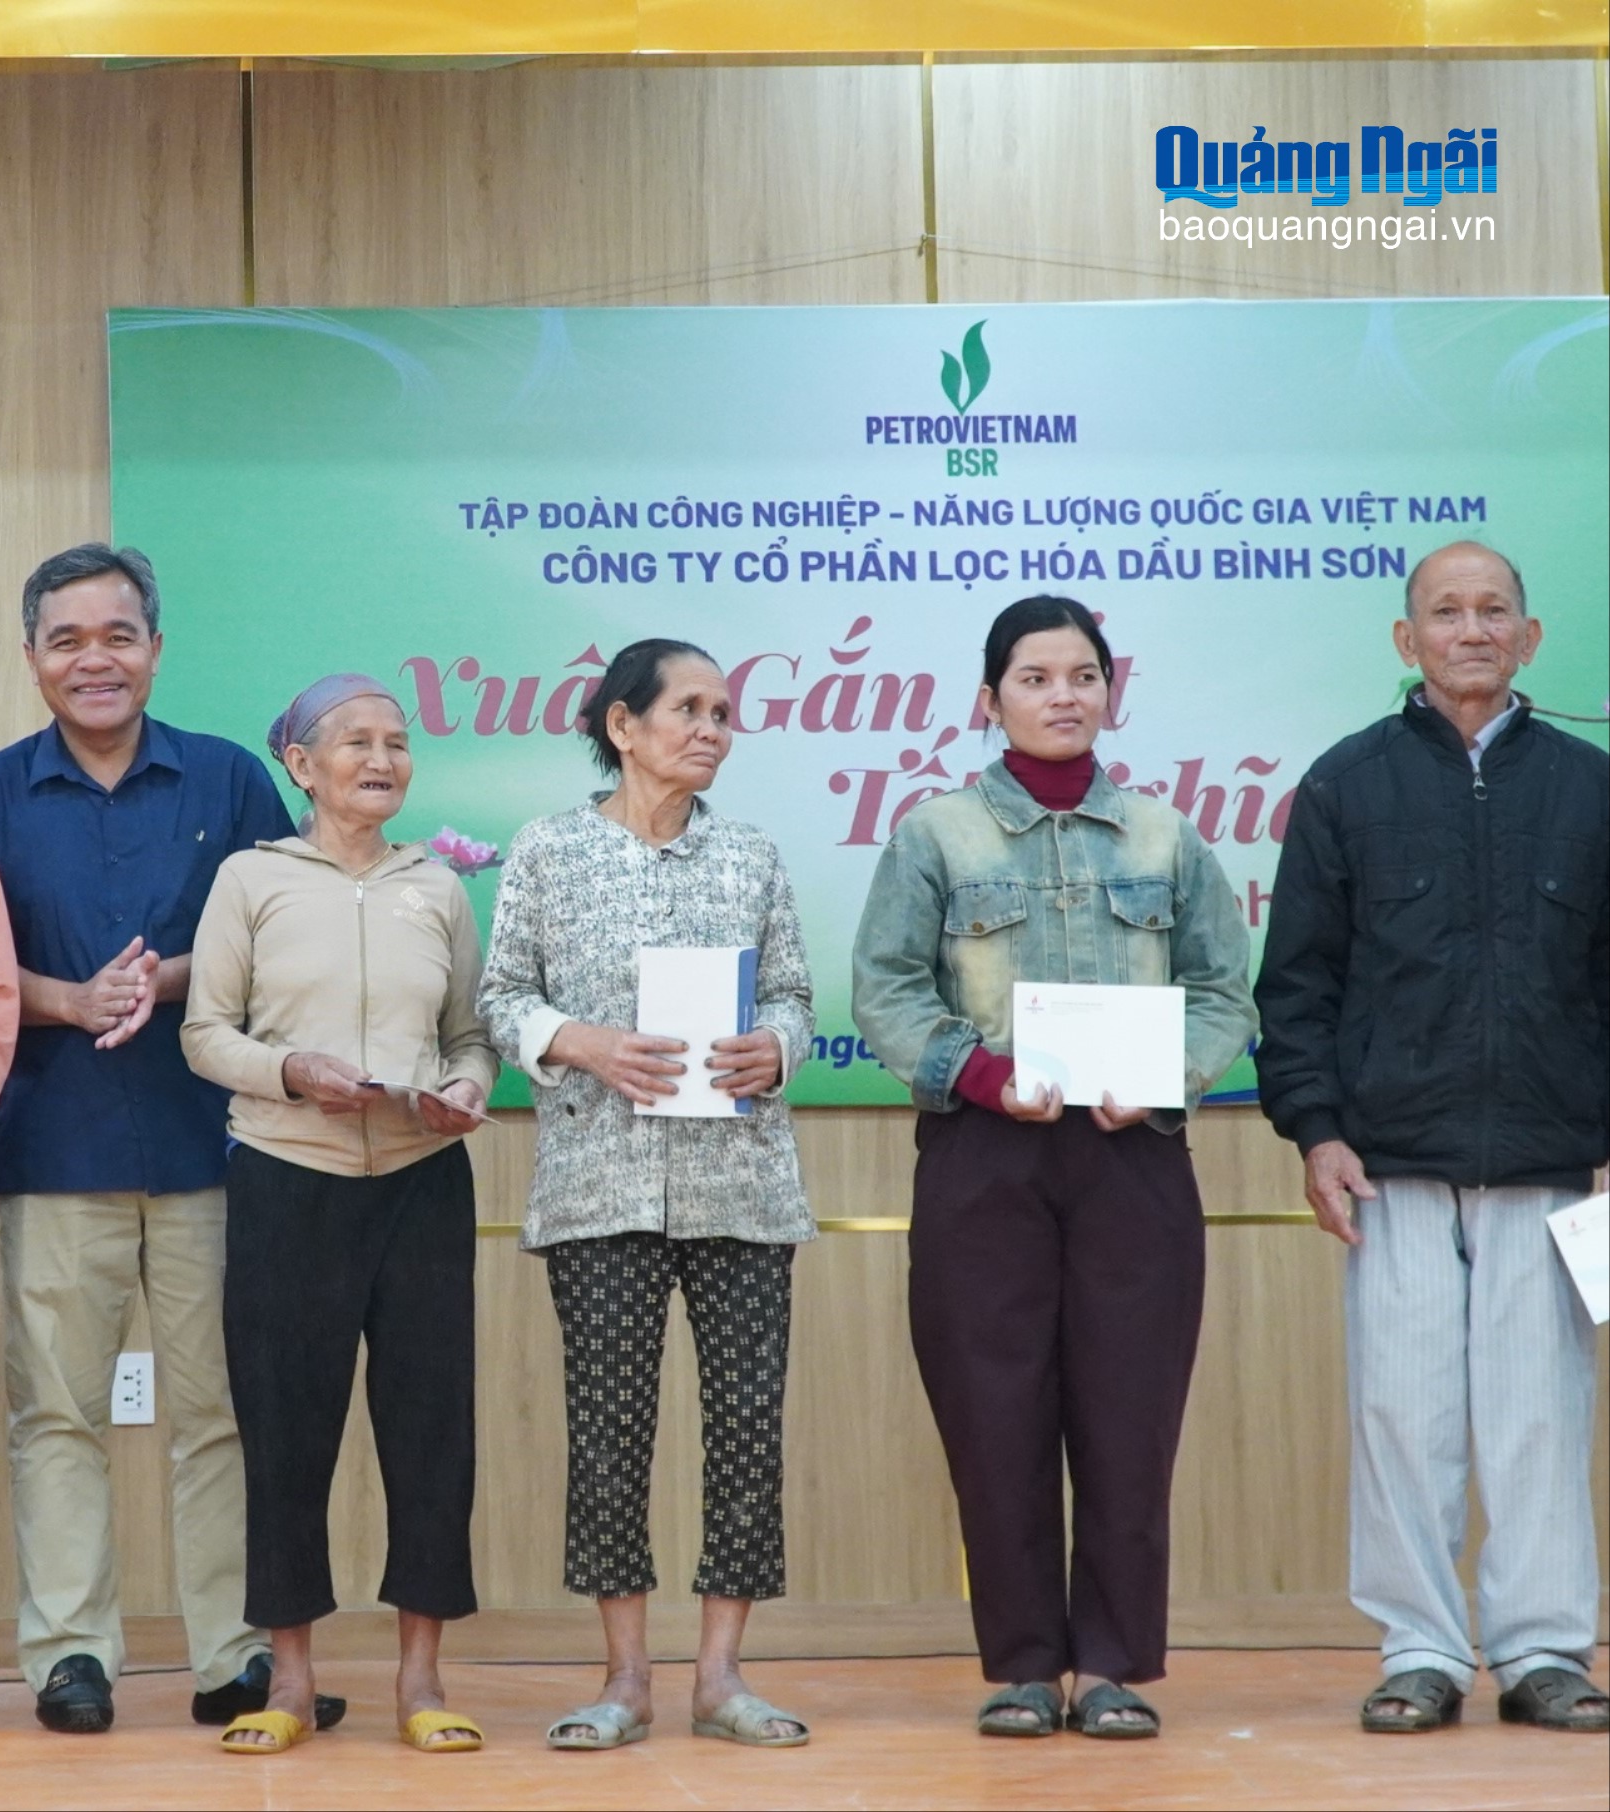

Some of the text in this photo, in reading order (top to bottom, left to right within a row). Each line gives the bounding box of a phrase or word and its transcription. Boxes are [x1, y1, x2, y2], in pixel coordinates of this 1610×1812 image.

[866, 414, 1077, 445] PETROVIETNAM
[946, 448, 999, 478] BSR
[459, 496, 528, 537] TẬP
[539, 494, 638, 530] ĐOÀN
[646, 494, 744, 529] CÔNG
[752, 494, 880, 536] NGHIỆP
[913, 494, 1014, 527] NĂNG
[1023, 496, 1140, 533] LƯỢNG
[1149, 489, 1243, 528] QUỐC
[1252, 497, 1311, 525] GIA
[1320, 490, 1399, 533] VIỆT
[1408, 496, 1487, 523] NAM
[542, 536, 1407, 591] CÔNG TY CỔ PHẦN LỌC HÓA DẦU BÌNH SƠN
[398, 643, 612, 736] Xuâ
[730, 615, 936, 734] Gắn
